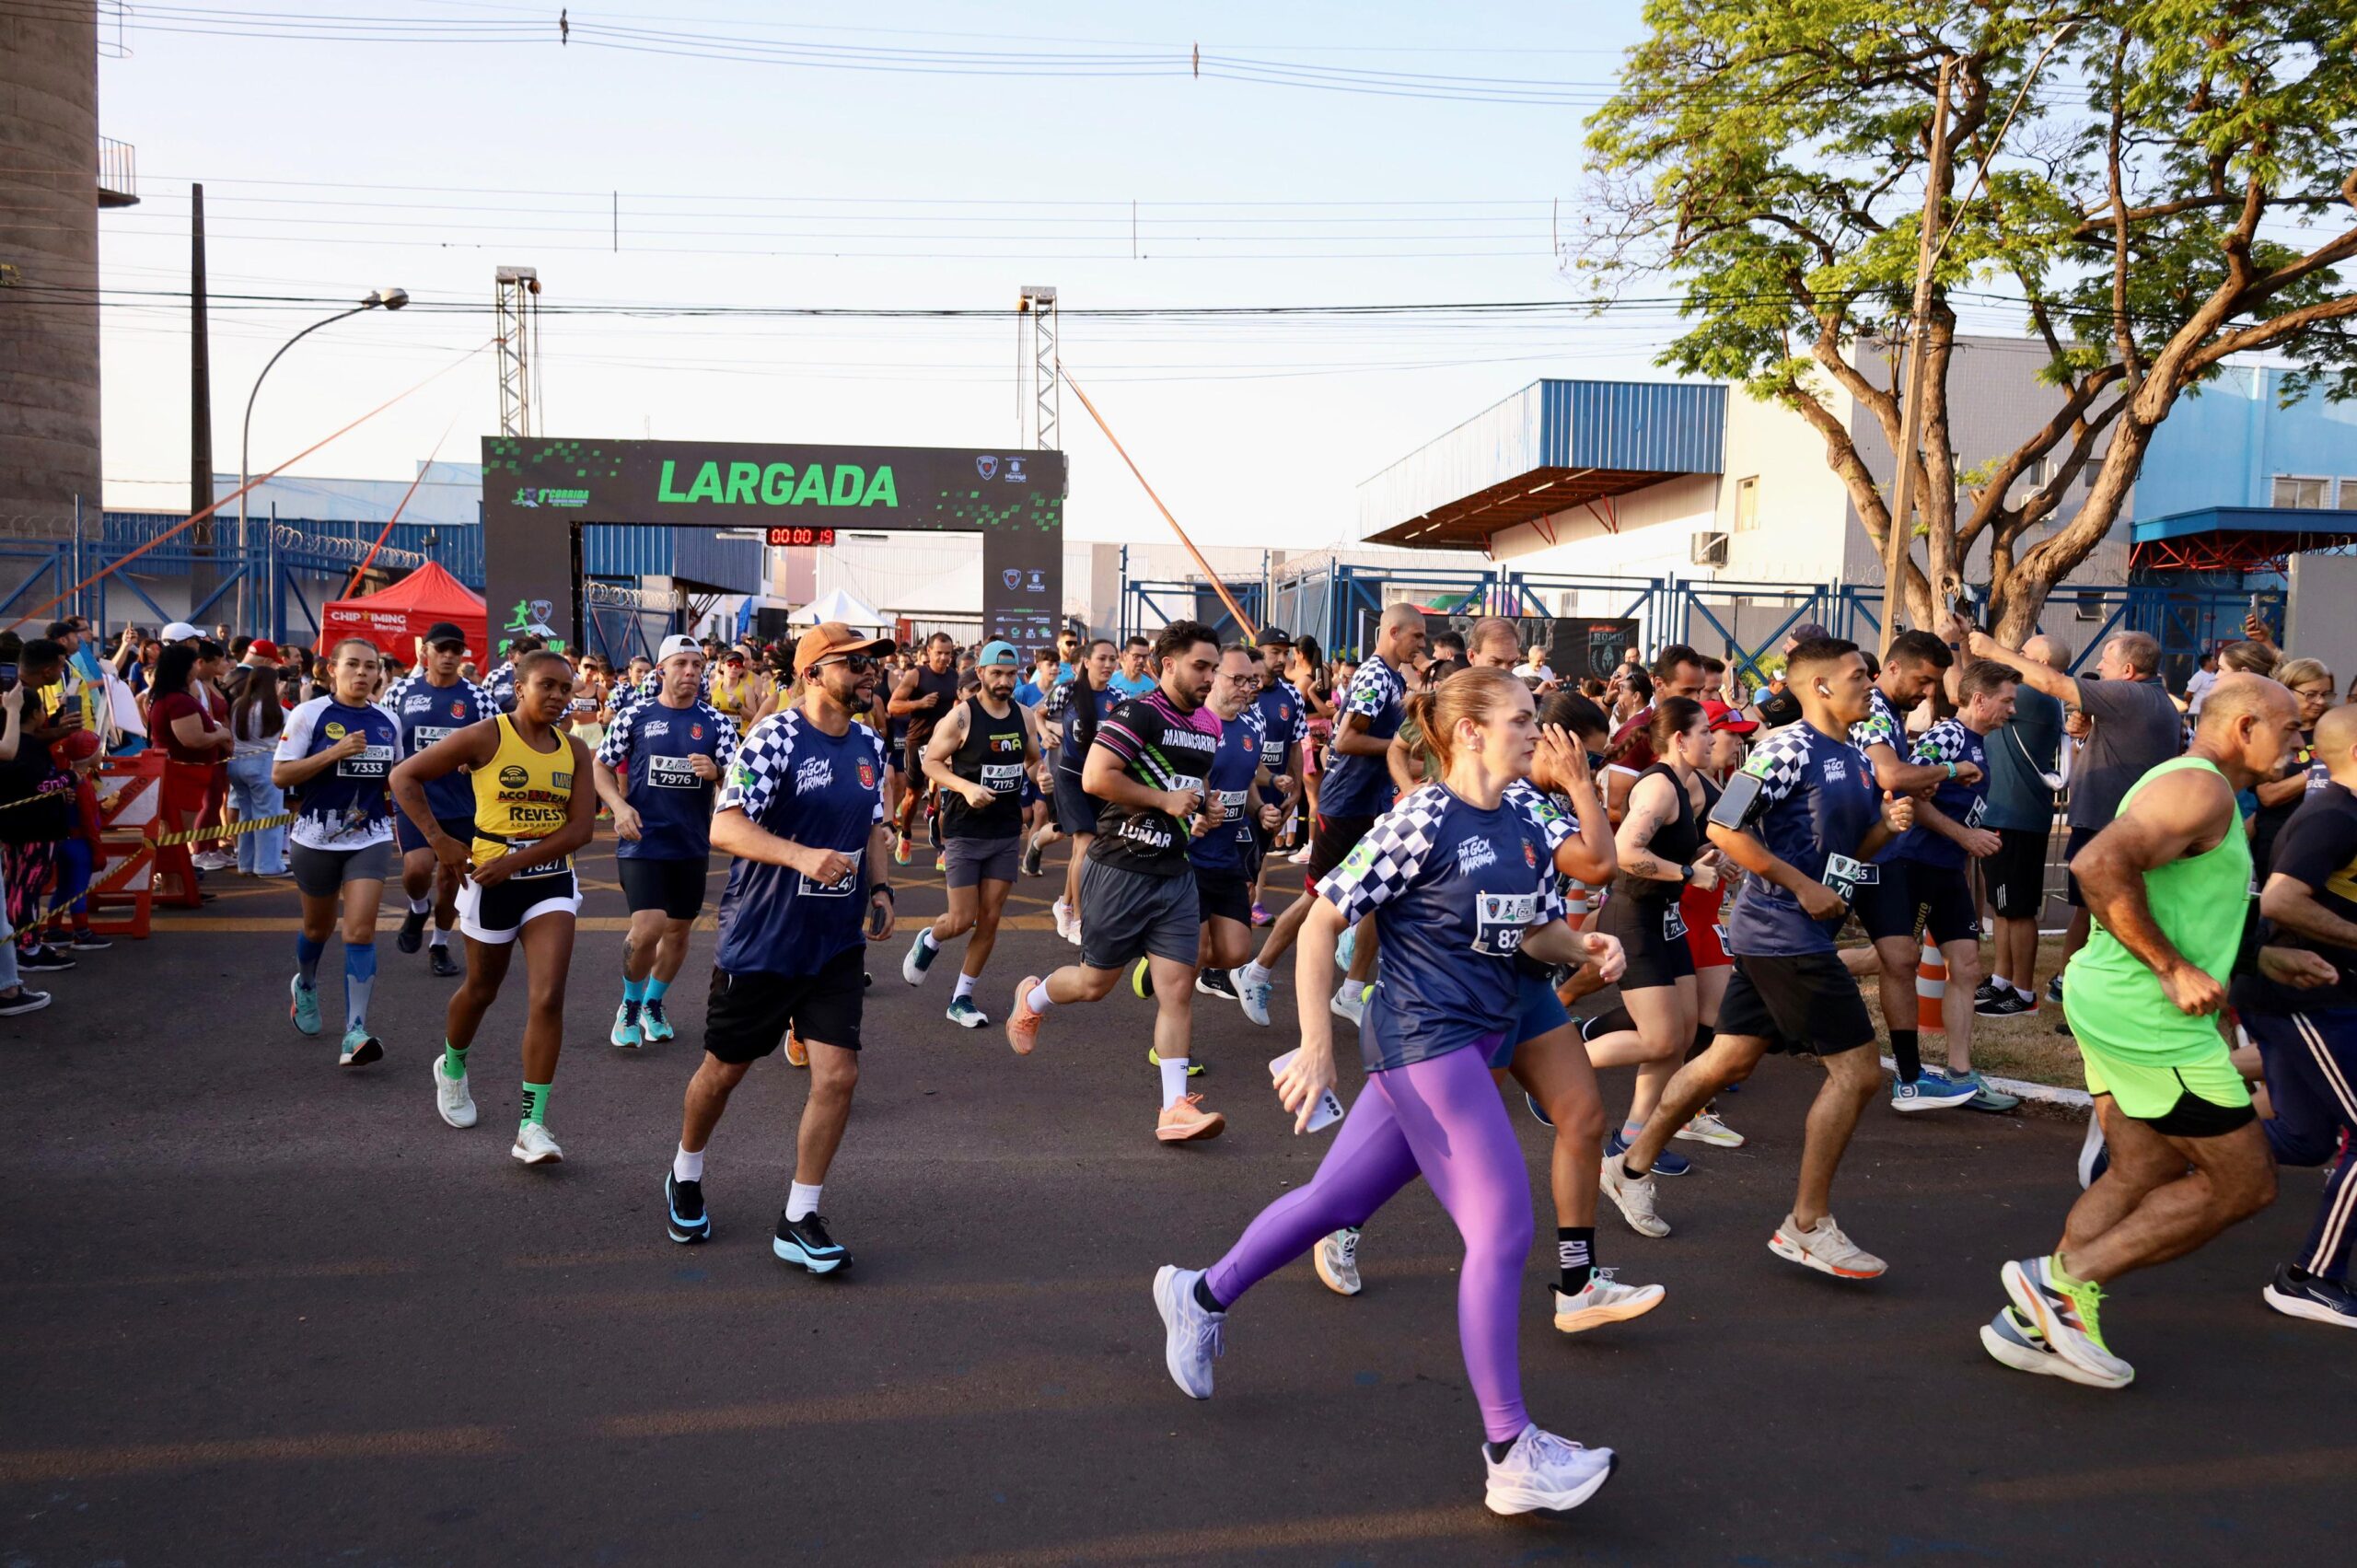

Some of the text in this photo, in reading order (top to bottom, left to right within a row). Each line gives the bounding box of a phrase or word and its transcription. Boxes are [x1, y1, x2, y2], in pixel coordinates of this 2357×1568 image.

[657, 460, 899, 507] LARGADA
[772, 528, 833, 544] 00 00 19
[990, 738, 1022, 752] EMA
[1261, 753, 1280, 762] 7018
[352, 762, 383, 773] 7333
[807, 758, 830, 776] GCM
[660, 772, 691, 784] 7976
[993, 779, 1015, 789] 7175
[1224, 807, 1238, 818] 281
[1118, 821, 1172, 848] LUMAR
[1459, 848, 1498, 877] MARINGÁ
[522, 1089, 536, 1120] RUN
[1559, 1240, 1590, 1269] RUN
